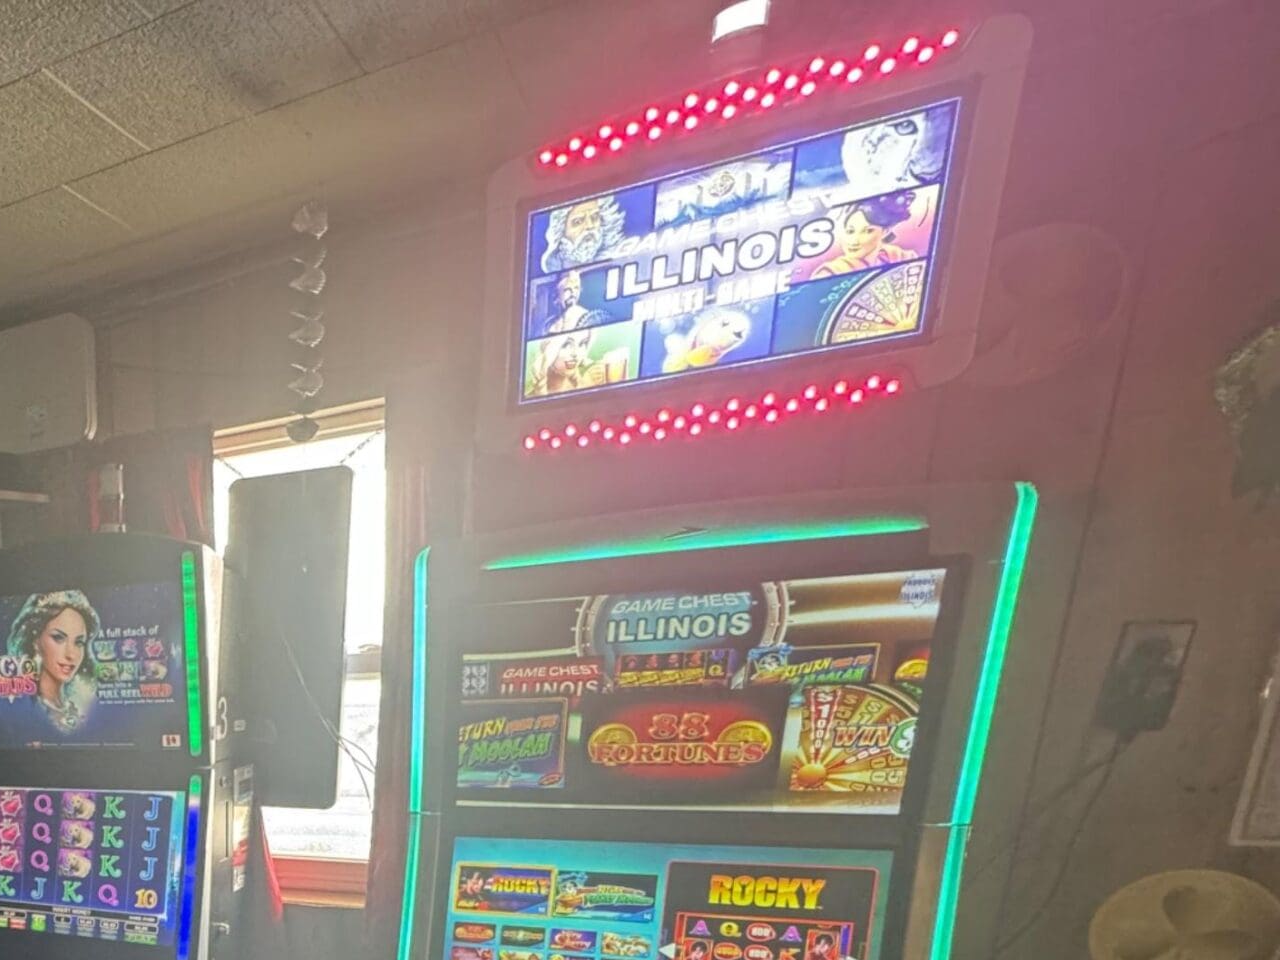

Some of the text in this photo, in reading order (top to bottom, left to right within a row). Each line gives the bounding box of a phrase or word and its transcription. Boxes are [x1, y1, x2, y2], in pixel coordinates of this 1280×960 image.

[605, 217, 836, 301] ILLINOIS
[611, 592, 751, 614] GAME CHEST
[605, 611, 752, 644] ILLINOIS
[503, 664, 598, 679] GAME CHEST
[218, 697, 228, 739] 3
[648, 712, 710, 740] 88
[591, 742, 767, 766] FORTUNES
[33, 794, 162, 821] Q K J
[32, 822, 160, 851] Q K J
[30, 850, 158, 881] Q K J
[30, 877, 47, 900] J
[61, 880, 84, 904] K
[97, 884, 119, 907] Q
[134, 888, 158, 910] 10
[708, 874, 827, 910] ROCKY
